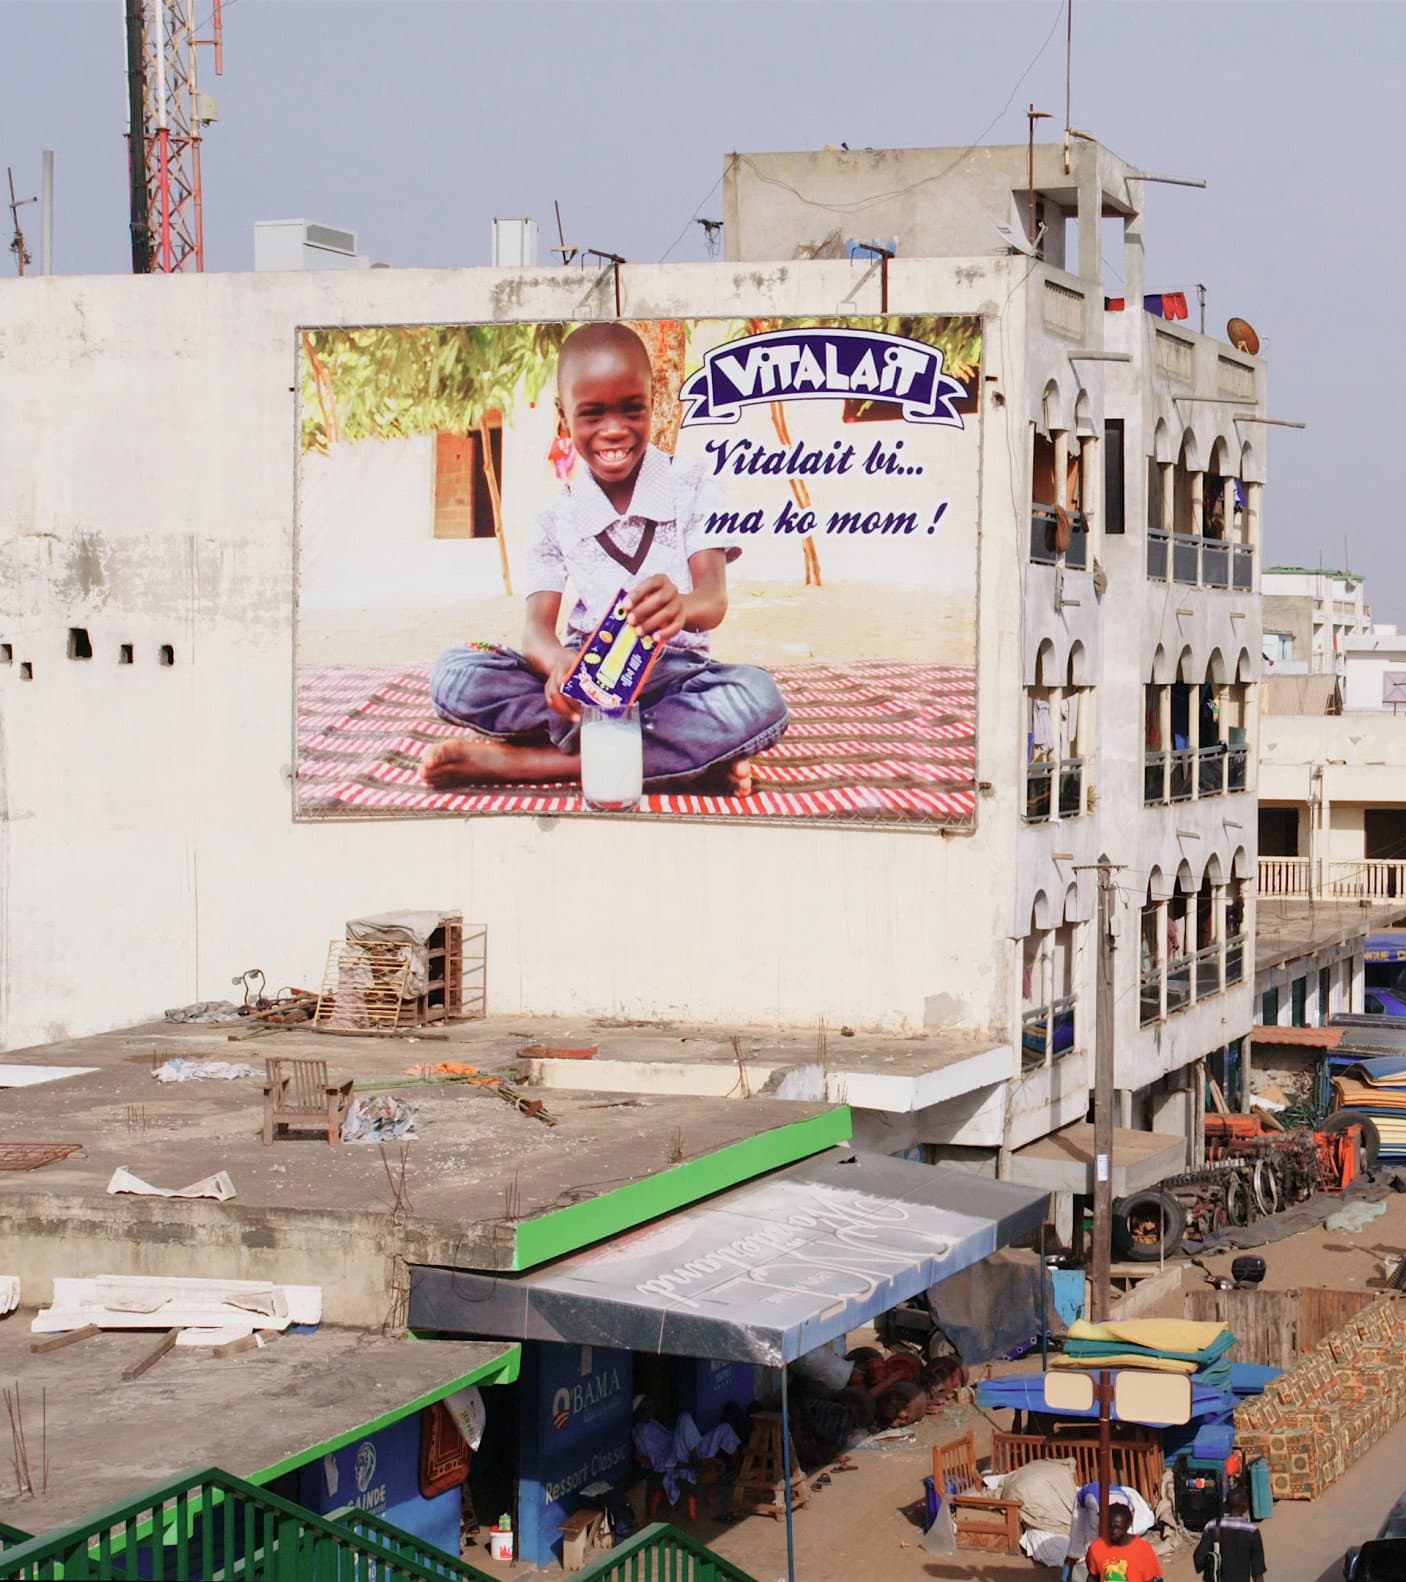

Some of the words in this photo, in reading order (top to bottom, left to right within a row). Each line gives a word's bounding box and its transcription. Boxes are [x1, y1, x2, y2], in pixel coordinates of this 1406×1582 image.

[704, 438, 857, 476] Vitalait
[862, 440, 924, 476] bi...
[703, 508, 765, 535] ma
[772, 499, 818, 535] ko
[825, 509, 919, 535] mom
[927, 502, 948, 535] !
[545, 1462, 589, 1506] Ressort
